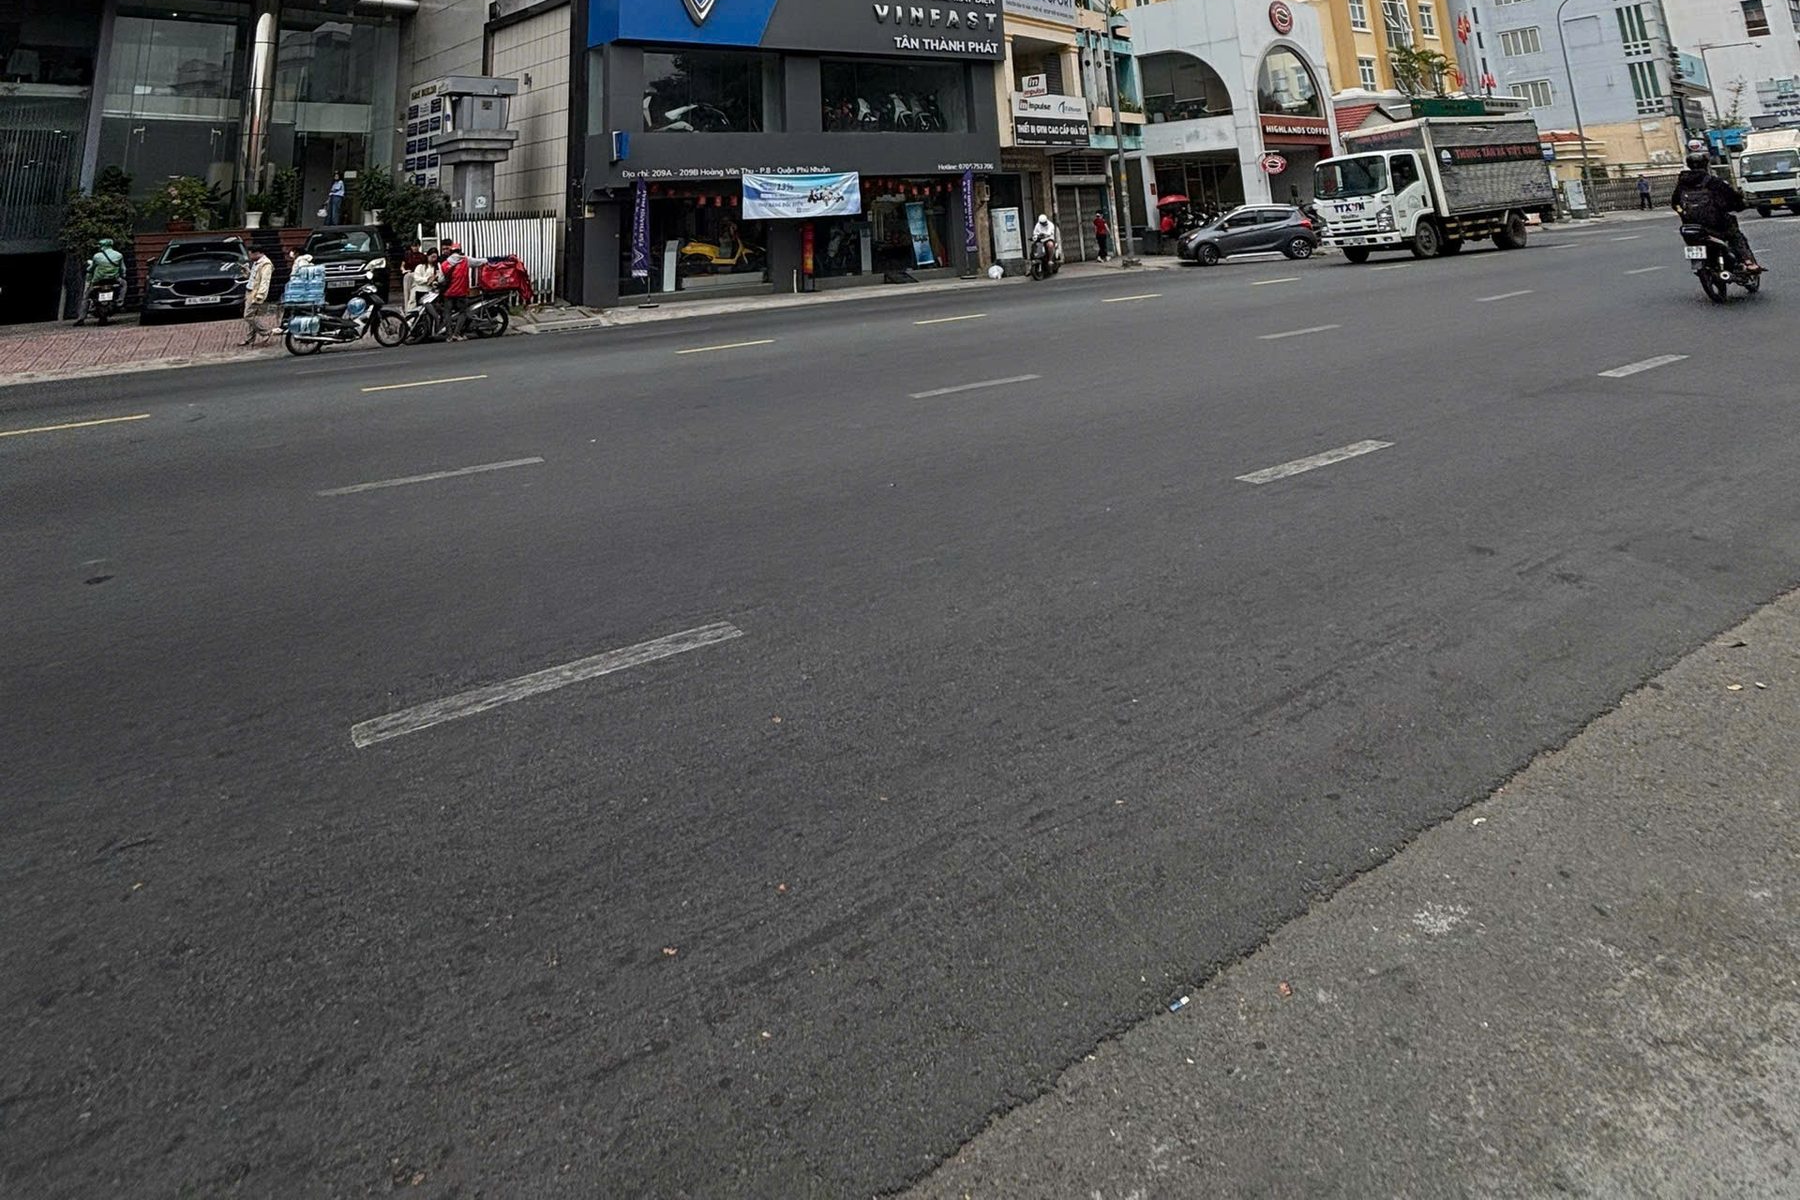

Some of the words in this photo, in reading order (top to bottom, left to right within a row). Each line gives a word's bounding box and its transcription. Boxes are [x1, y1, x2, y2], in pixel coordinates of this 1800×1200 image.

[873, 4, 998, 31] VINFAST
[894, 34, 920, 50] TÂN
[922, 36, 966, 52] THÀNH
[967, 39, 999, 54] PHÁT
[1048, 125, 1059, 134] CAO
[1265, 124, 1306, 135] HIGHLANDS
[1306, 126, 1330, 136] COFFEE
[651, 169, 673, 177] 209A
[679, 168, 699, 176] 209B
